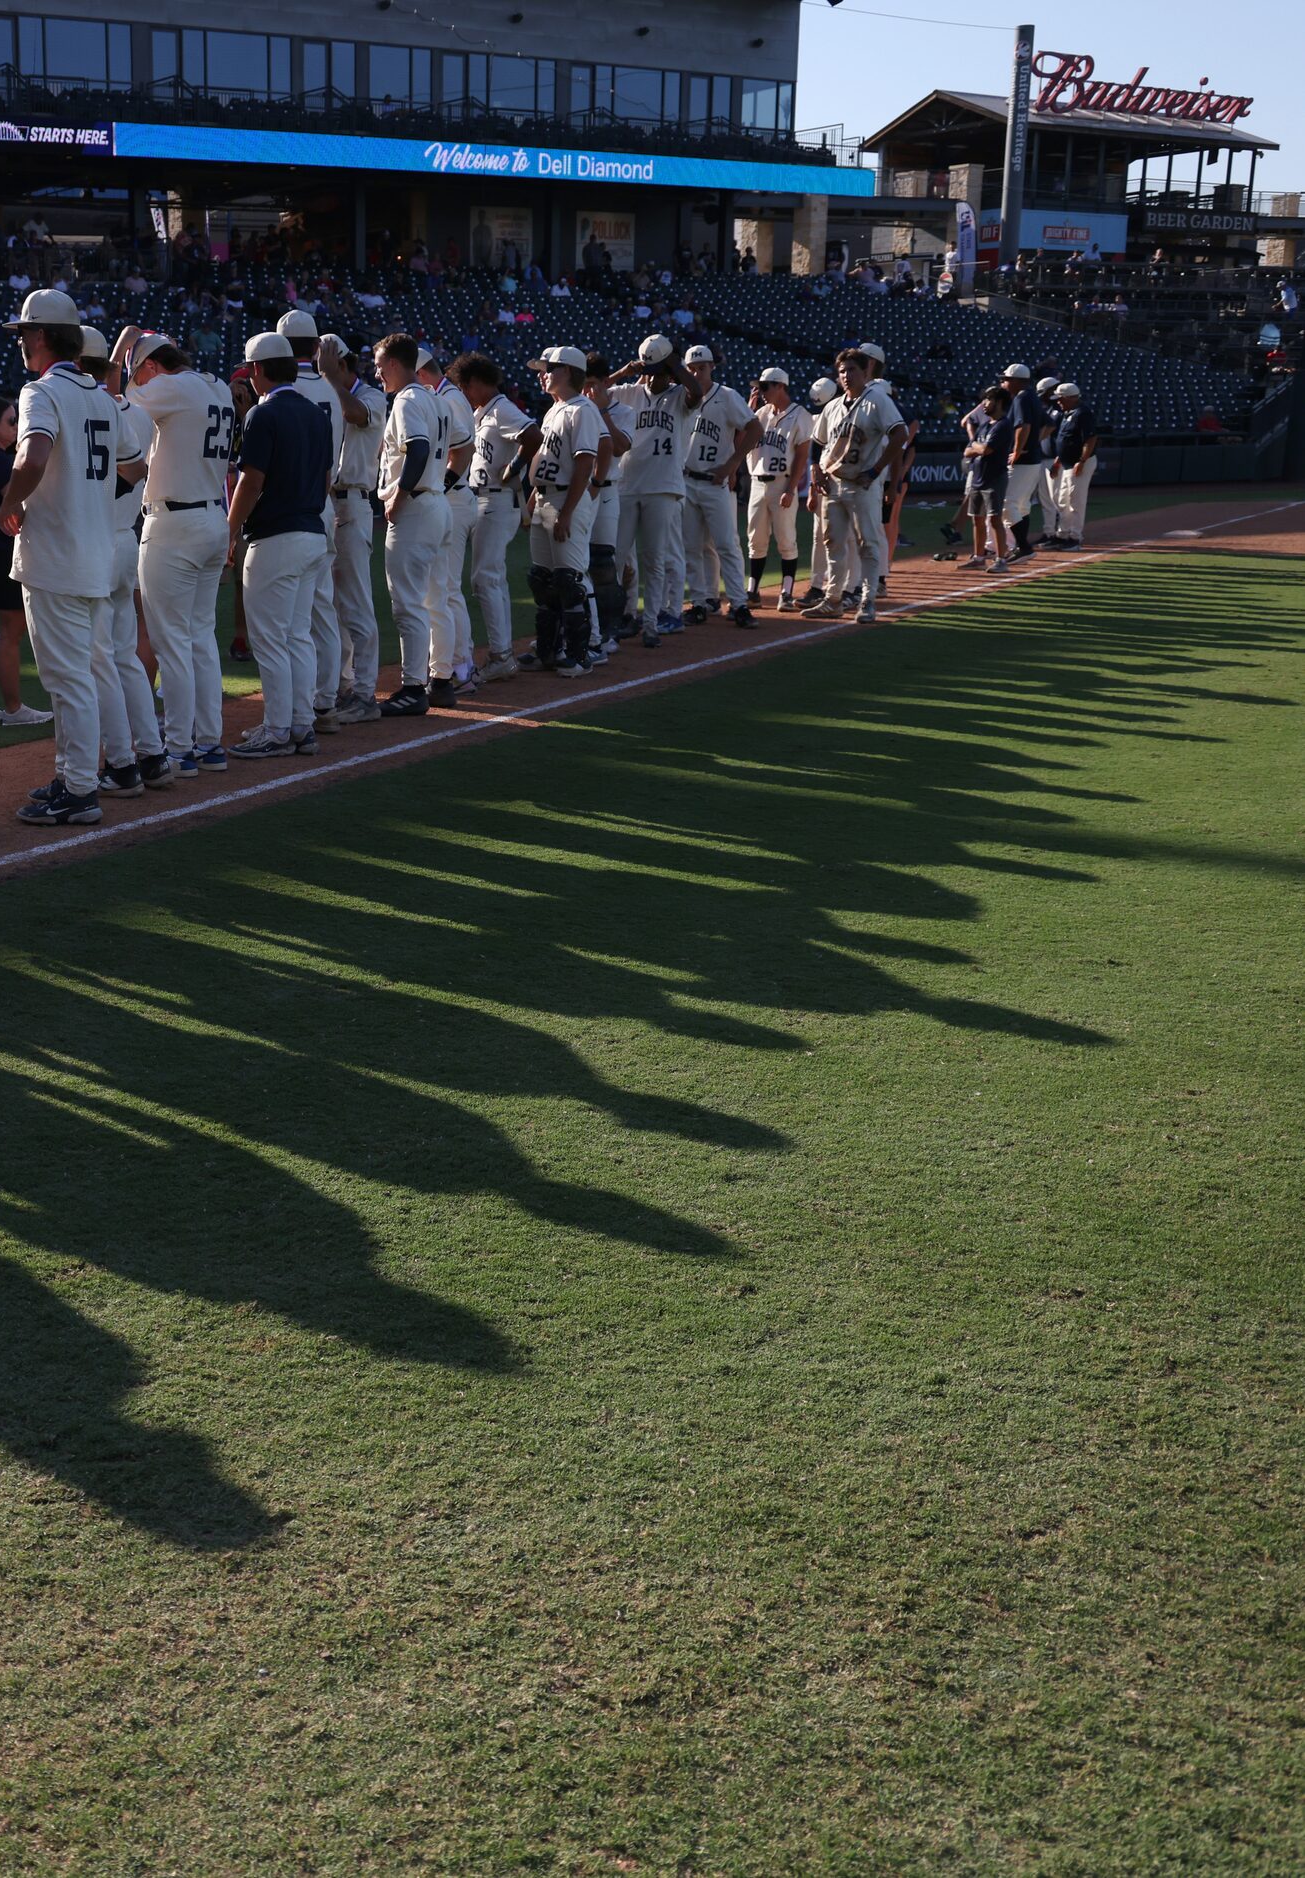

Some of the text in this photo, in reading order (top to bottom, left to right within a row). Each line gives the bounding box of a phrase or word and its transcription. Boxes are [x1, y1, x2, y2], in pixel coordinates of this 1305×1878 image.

[1018, 65, 1030, 109] United
[1032, 50, 1254, 123] Budweiser
[30, 127, 74, 145] STARTS
[75, 129, 109, 146] HERE.
[1012, 113, 1027, 172] Heritage
[424, 142, 653, 180] Welcome to Dell Diamond
[1147, 211, 1254, 231] BEER GARDEN
[203, 405, 235, 459] 23
[84, 418, 110, 481] 15
[653, 438, 673, 456] 14
[698, 445, 718, 462] 12
[535, 460, 560, 482] 22
[769, 457, 788, 472] 26
[910, 465, 959, 482] KONICA
